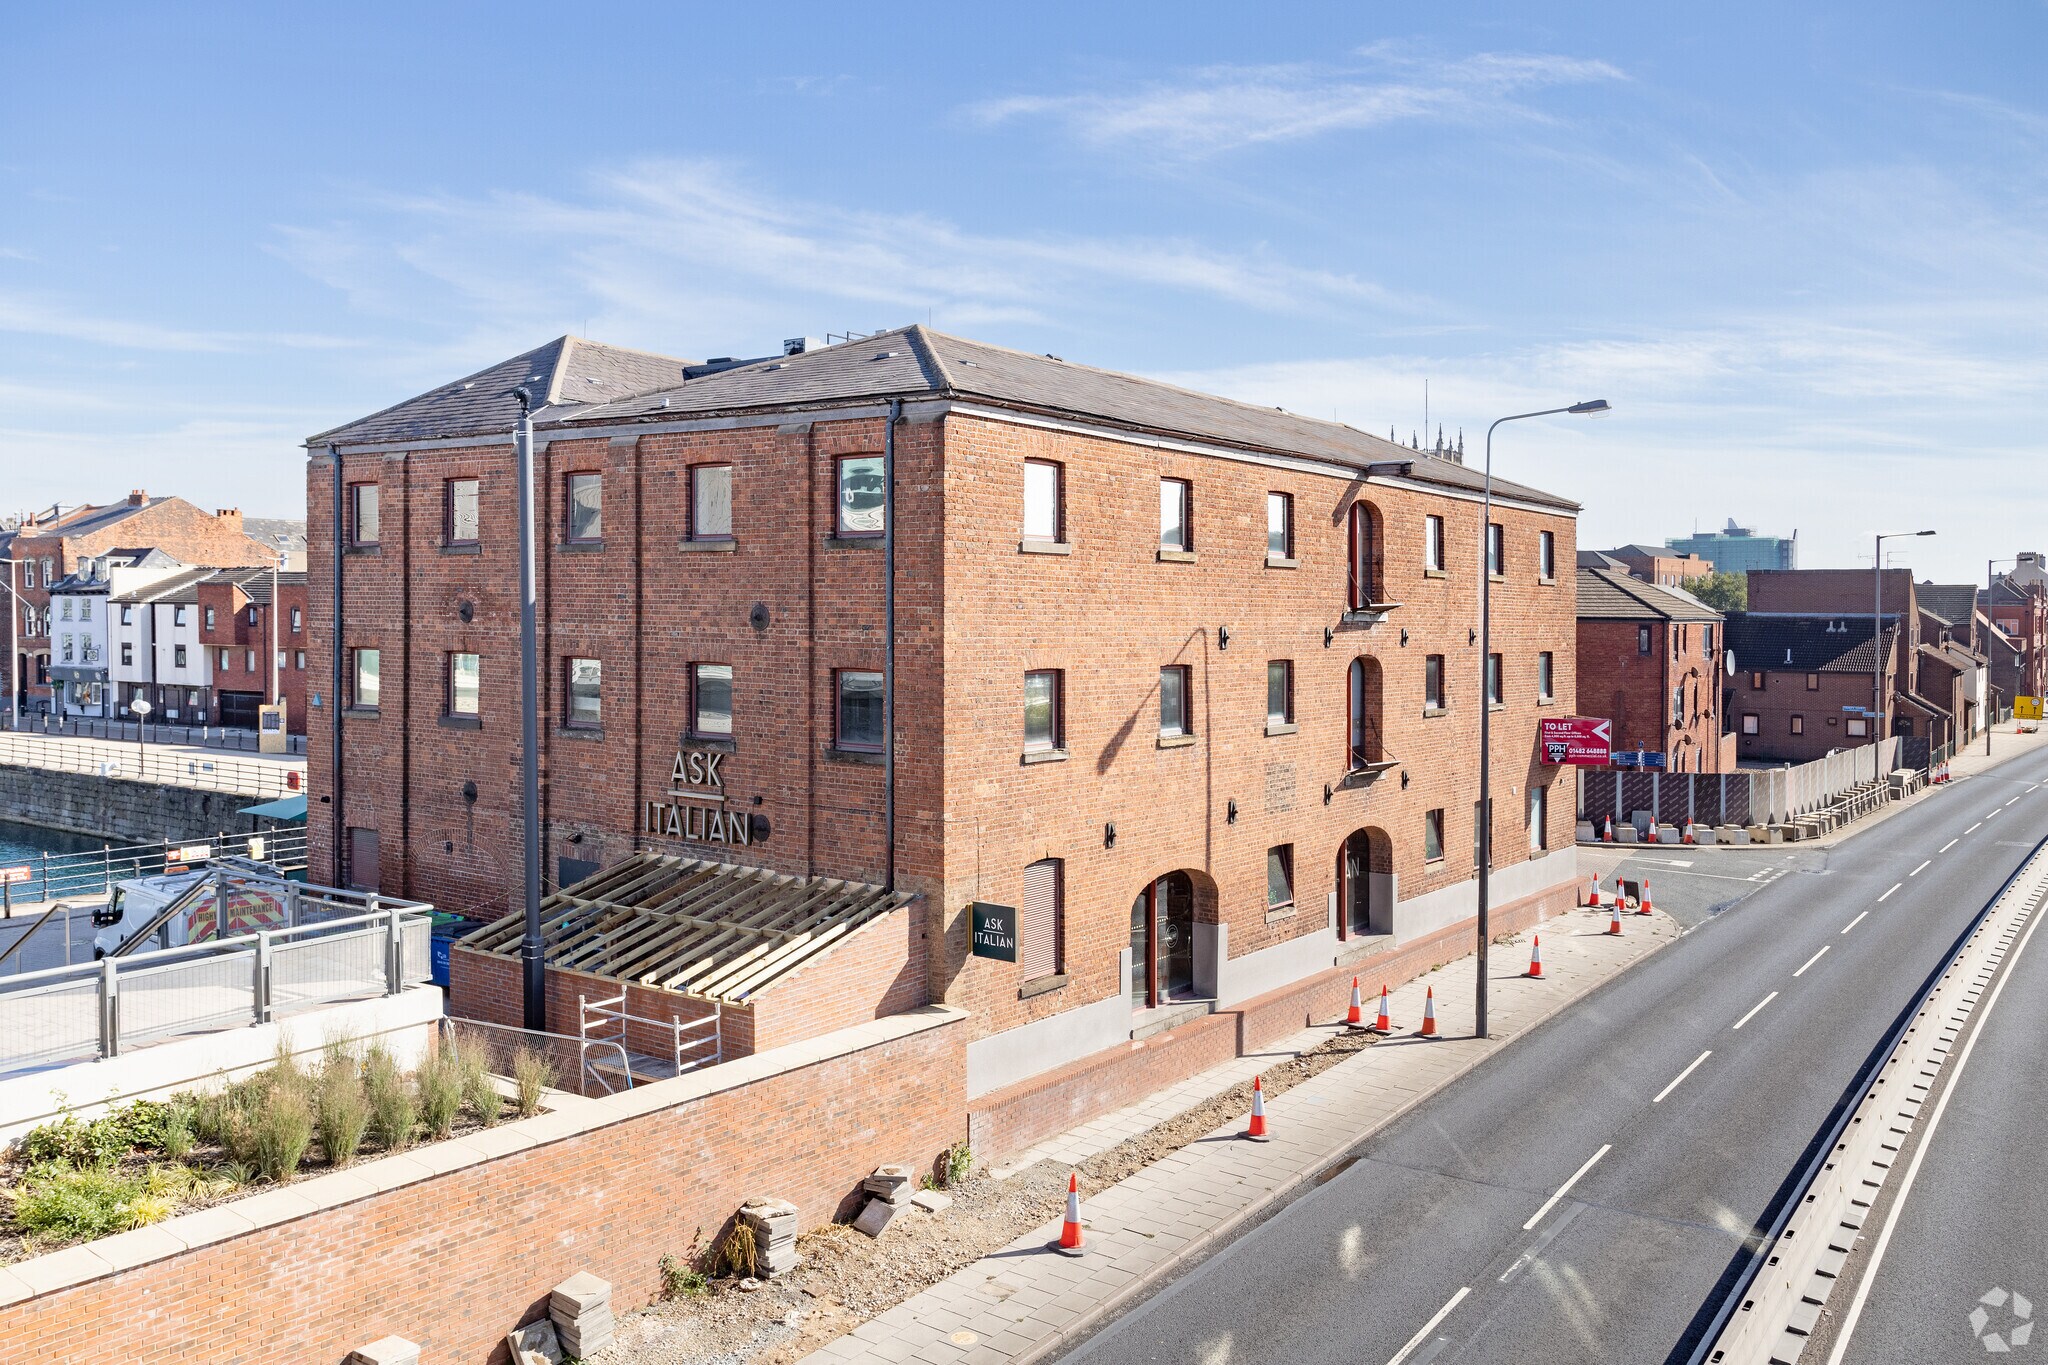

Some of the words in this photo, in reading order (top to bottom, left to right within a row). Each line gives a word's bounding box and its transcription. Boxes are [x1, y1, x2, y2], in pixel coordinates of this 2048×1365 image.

[1544, 723, 1556, 731] TO
[1558, 723, 1573, 731] LET
[1549, 745, 1566, 753] PPH
[671, 750, 724, 787] ASK
[645, 801, 752, 847] ITALIAN
[229, 903, 273, 918] MAINTENANCE
[984, 918, 1003, 931] ASK
[974, 932, 1013, 948] ITALIAN
